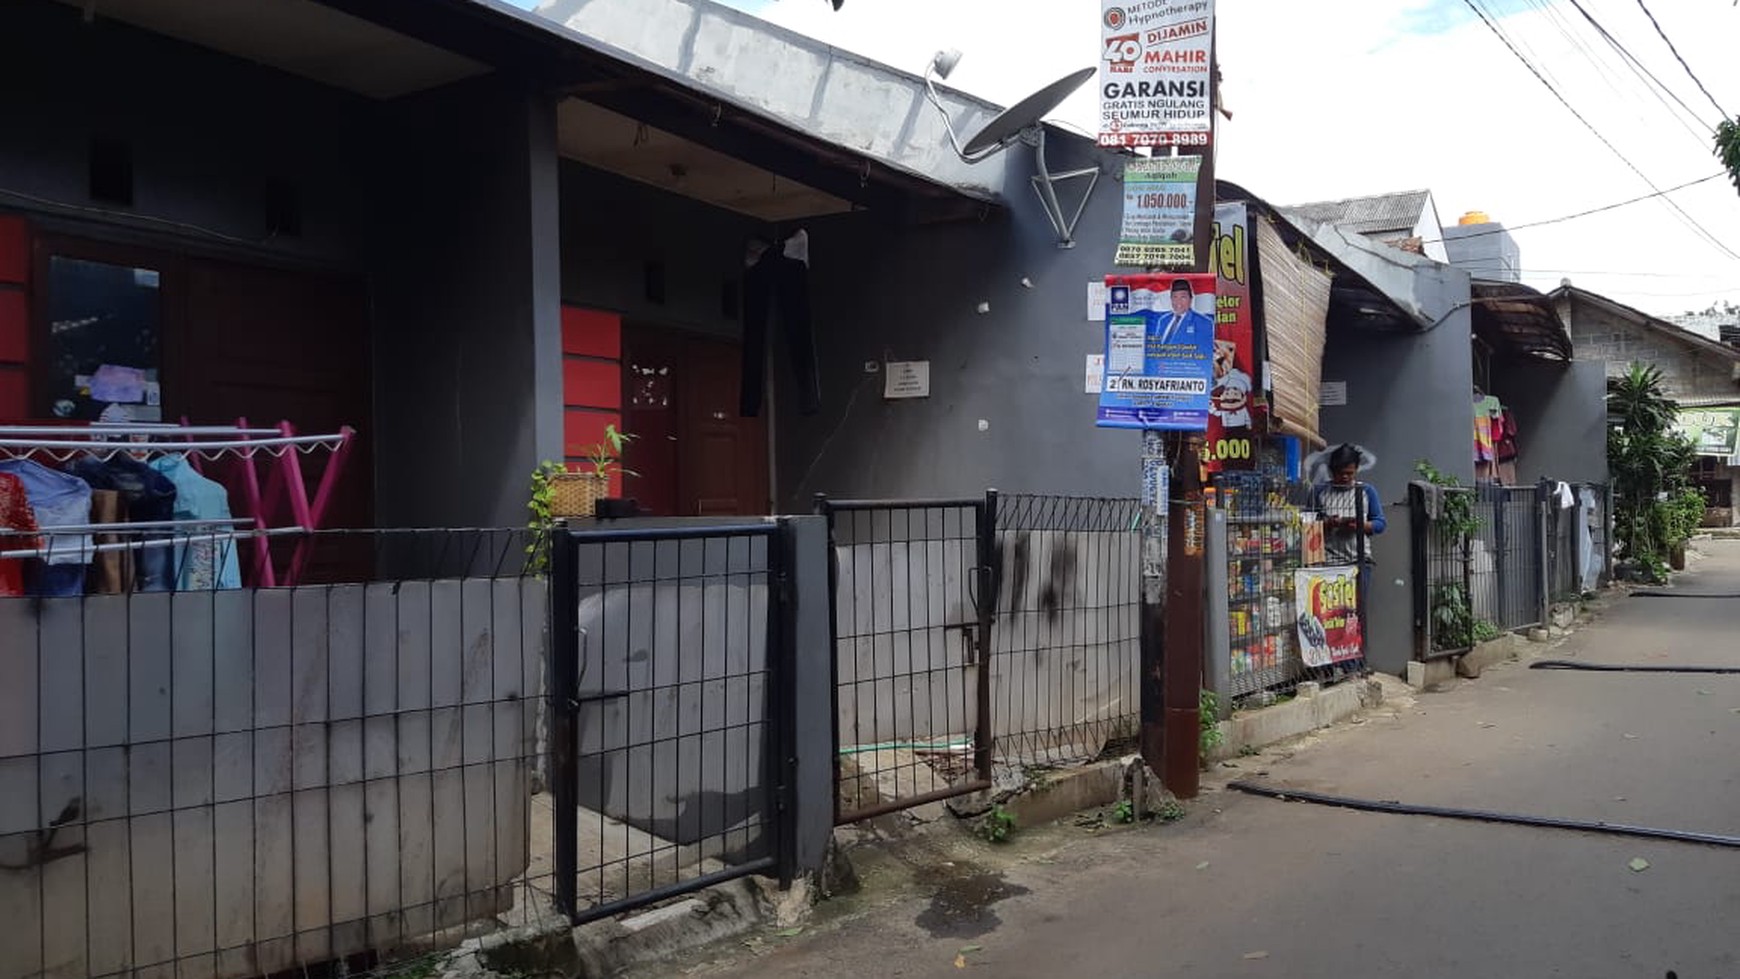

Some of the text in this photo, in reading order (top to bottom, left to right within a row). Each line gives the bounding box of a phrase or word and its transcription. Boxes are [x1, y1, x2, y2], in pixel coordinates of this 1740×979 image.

[1128, 2, 1208, 25] Hypnotherapy
[1147, 21, 1208, 43] DIJAMIN
[1103, 39, 1142, 63] 40
[1144, 50, 1206, 63] MAHIR
[1103, 80, 1205, 99] GARANSI
[1103, 100, 1205, 110] GRATIS NGULANG
[1102, 109, 1205, 120] SEUMUR HIDUP
[1100, 134, 1126, 146] 081
[1172, 133, 1208, 145] 8989
[1217, 296, 1240, 308] elor
[1109, 380, 1116, 389] 2
[1138, 379, 1205, 392] ROSYAFRIANTO
